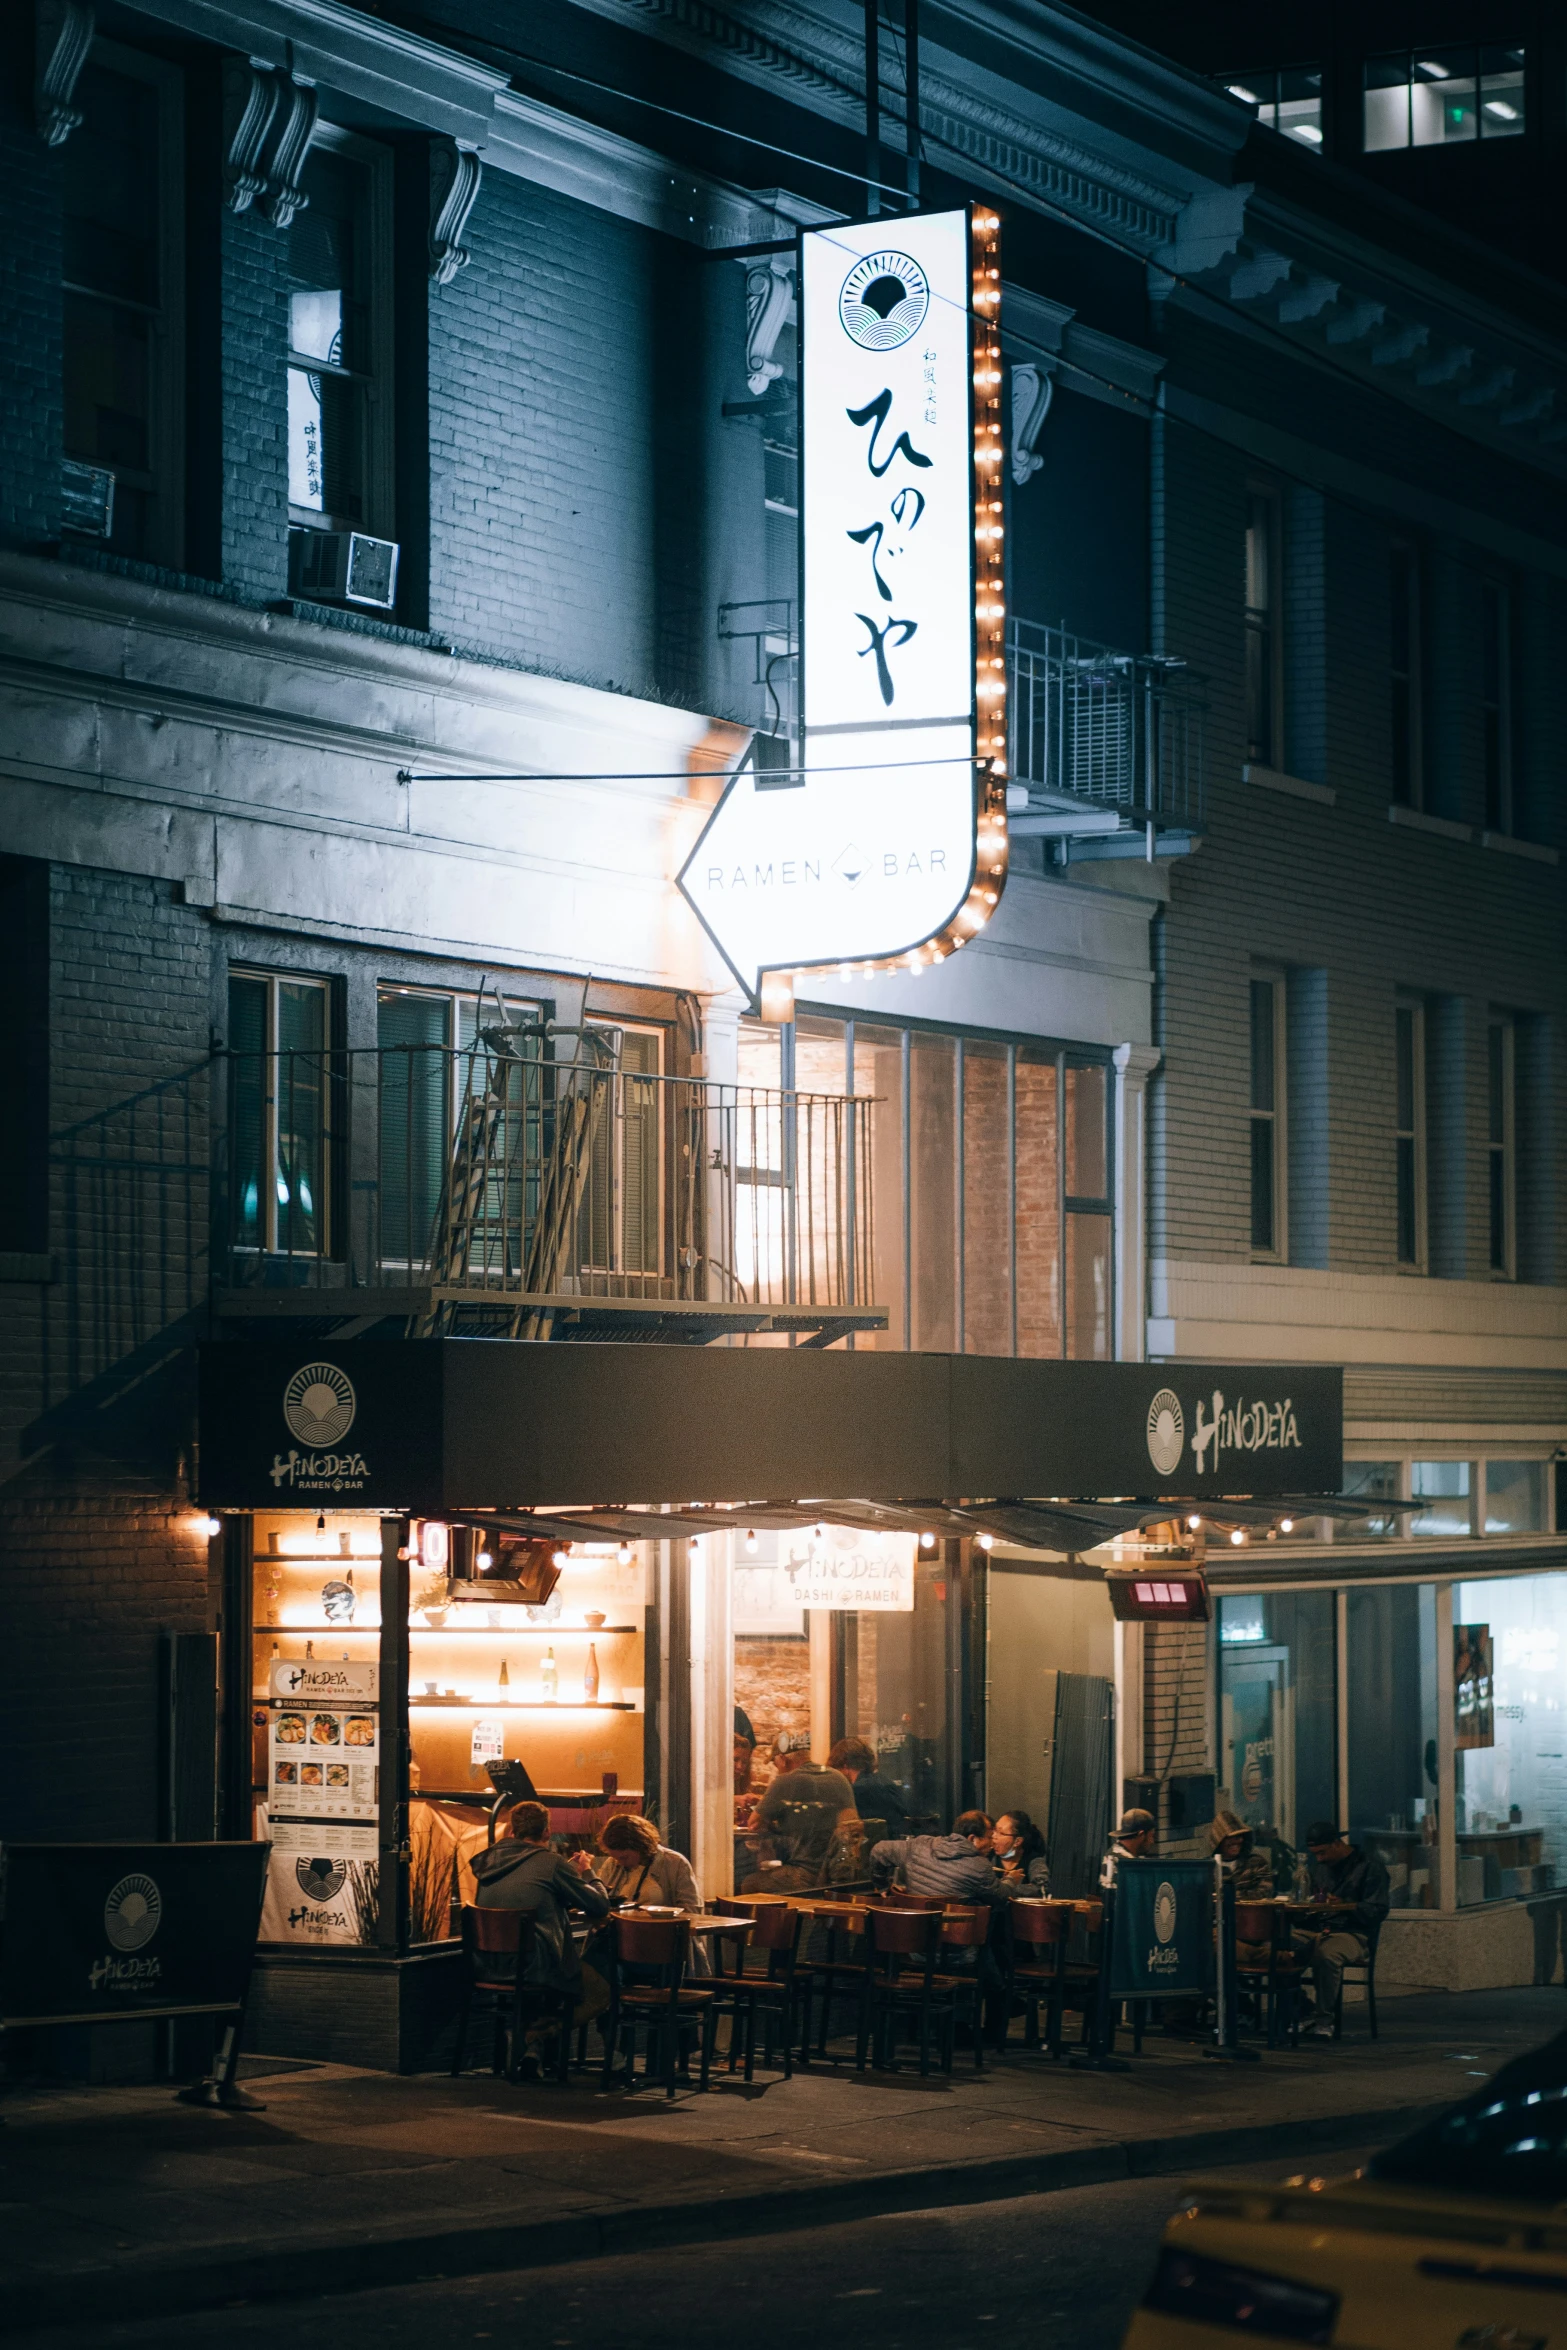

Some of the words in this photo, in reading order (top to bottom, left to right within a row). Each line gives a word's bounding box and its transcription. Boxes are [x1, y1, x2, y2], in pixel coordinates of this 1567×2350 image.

[846, 387, 934, 708] ひのでや
[708, 859, 821, 890] RAMEN
[883, 849, 947, 876] BAR
[1191, 1389, 1302, 1475] HINODEYA
[269, 1450, 371, 1487] HINODEYA
[298, 1481, 331, 1489] RAMEN
[344, 1481, 364, 1489] BAR
[784, 1542, 906, 1584] HINODEYA
[795, 1588, 833, 1601] DASHI
[855, 1589, 899, 1602] RAMEN
[288, 1667, 349, 1690] HINODEYA
[88, 1955, 163, 1989] HINODEYA
